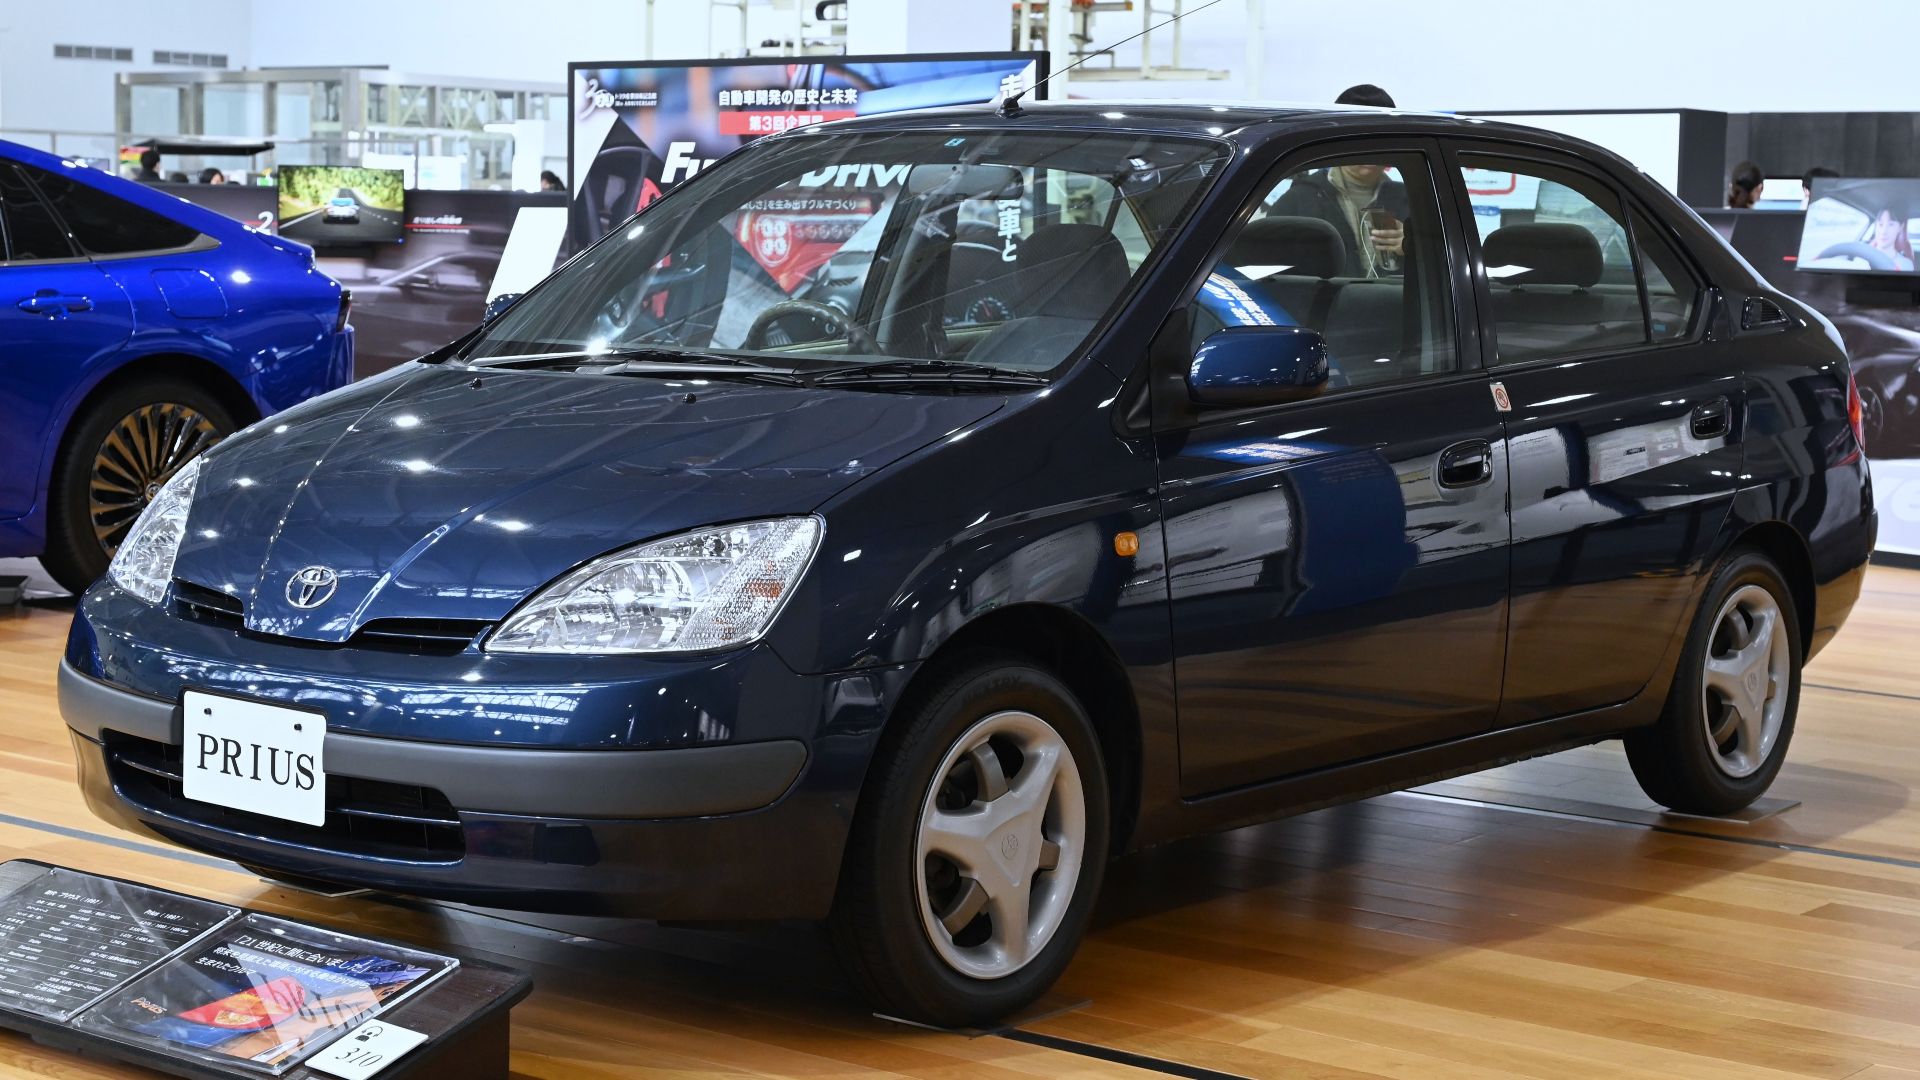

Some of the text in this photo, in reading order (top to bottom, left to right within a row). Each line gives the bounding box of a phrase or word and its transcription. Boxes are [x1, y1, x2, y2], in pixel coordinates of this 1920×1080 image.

[719, 89, 857, 106] 自動車開発の歴史と未来
[997, 200, 1020, 262] 車と
[197, 733, 315, 790] PRIUS
[334, 1047, 383, 1067] 310
